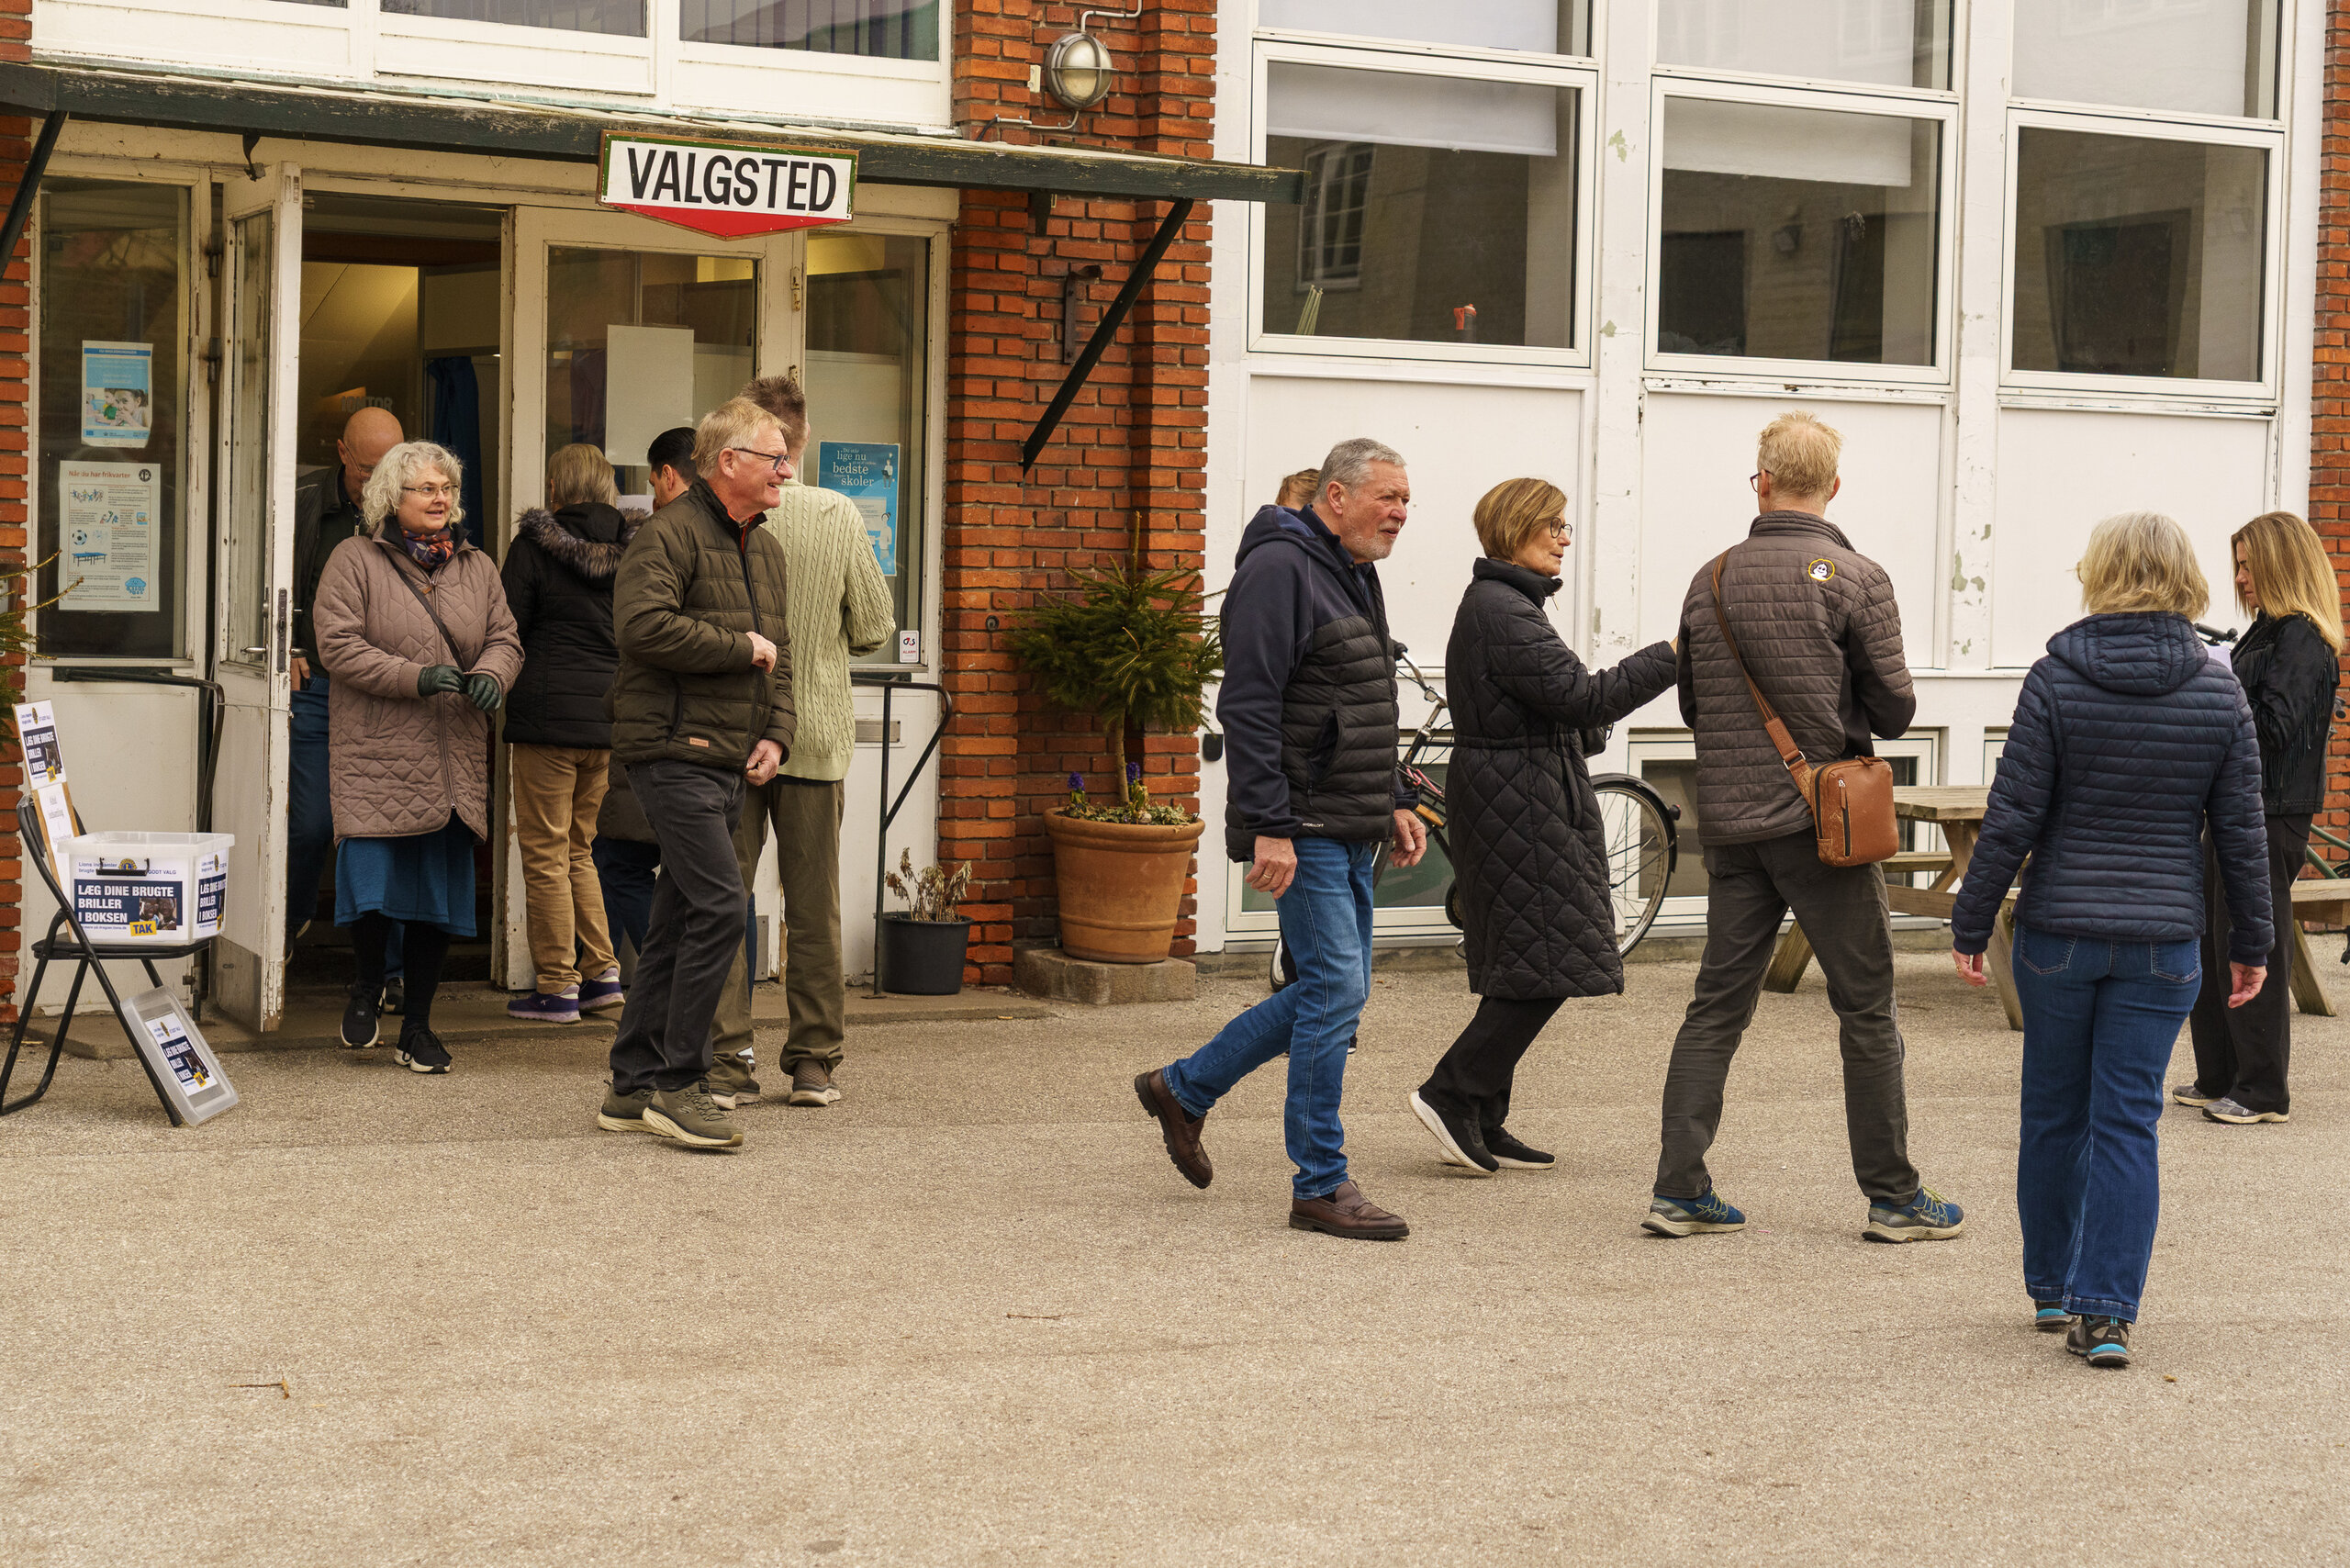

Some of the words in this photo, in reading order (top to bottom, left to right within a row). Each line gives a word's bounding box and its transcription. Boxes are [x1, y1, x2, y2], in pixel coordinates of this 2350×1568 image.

[627, 147, 836, 212] VALGSTED
[836, 450, 853, 462] lige
[833, 462, 869, 475] bedste
[841, 475, 875, 487] skoler
[78, 885, 102, 896] LÆG
[104, 885, 129, 896] DINE
[132, 886, 174, 897] BRUGTE
[78, 898, 122, 909] BRILLER
[78, 912, 82, 922] I
[84, 913, 128, 923] BOKSEN
[133, 924, 153, 935] TAK
